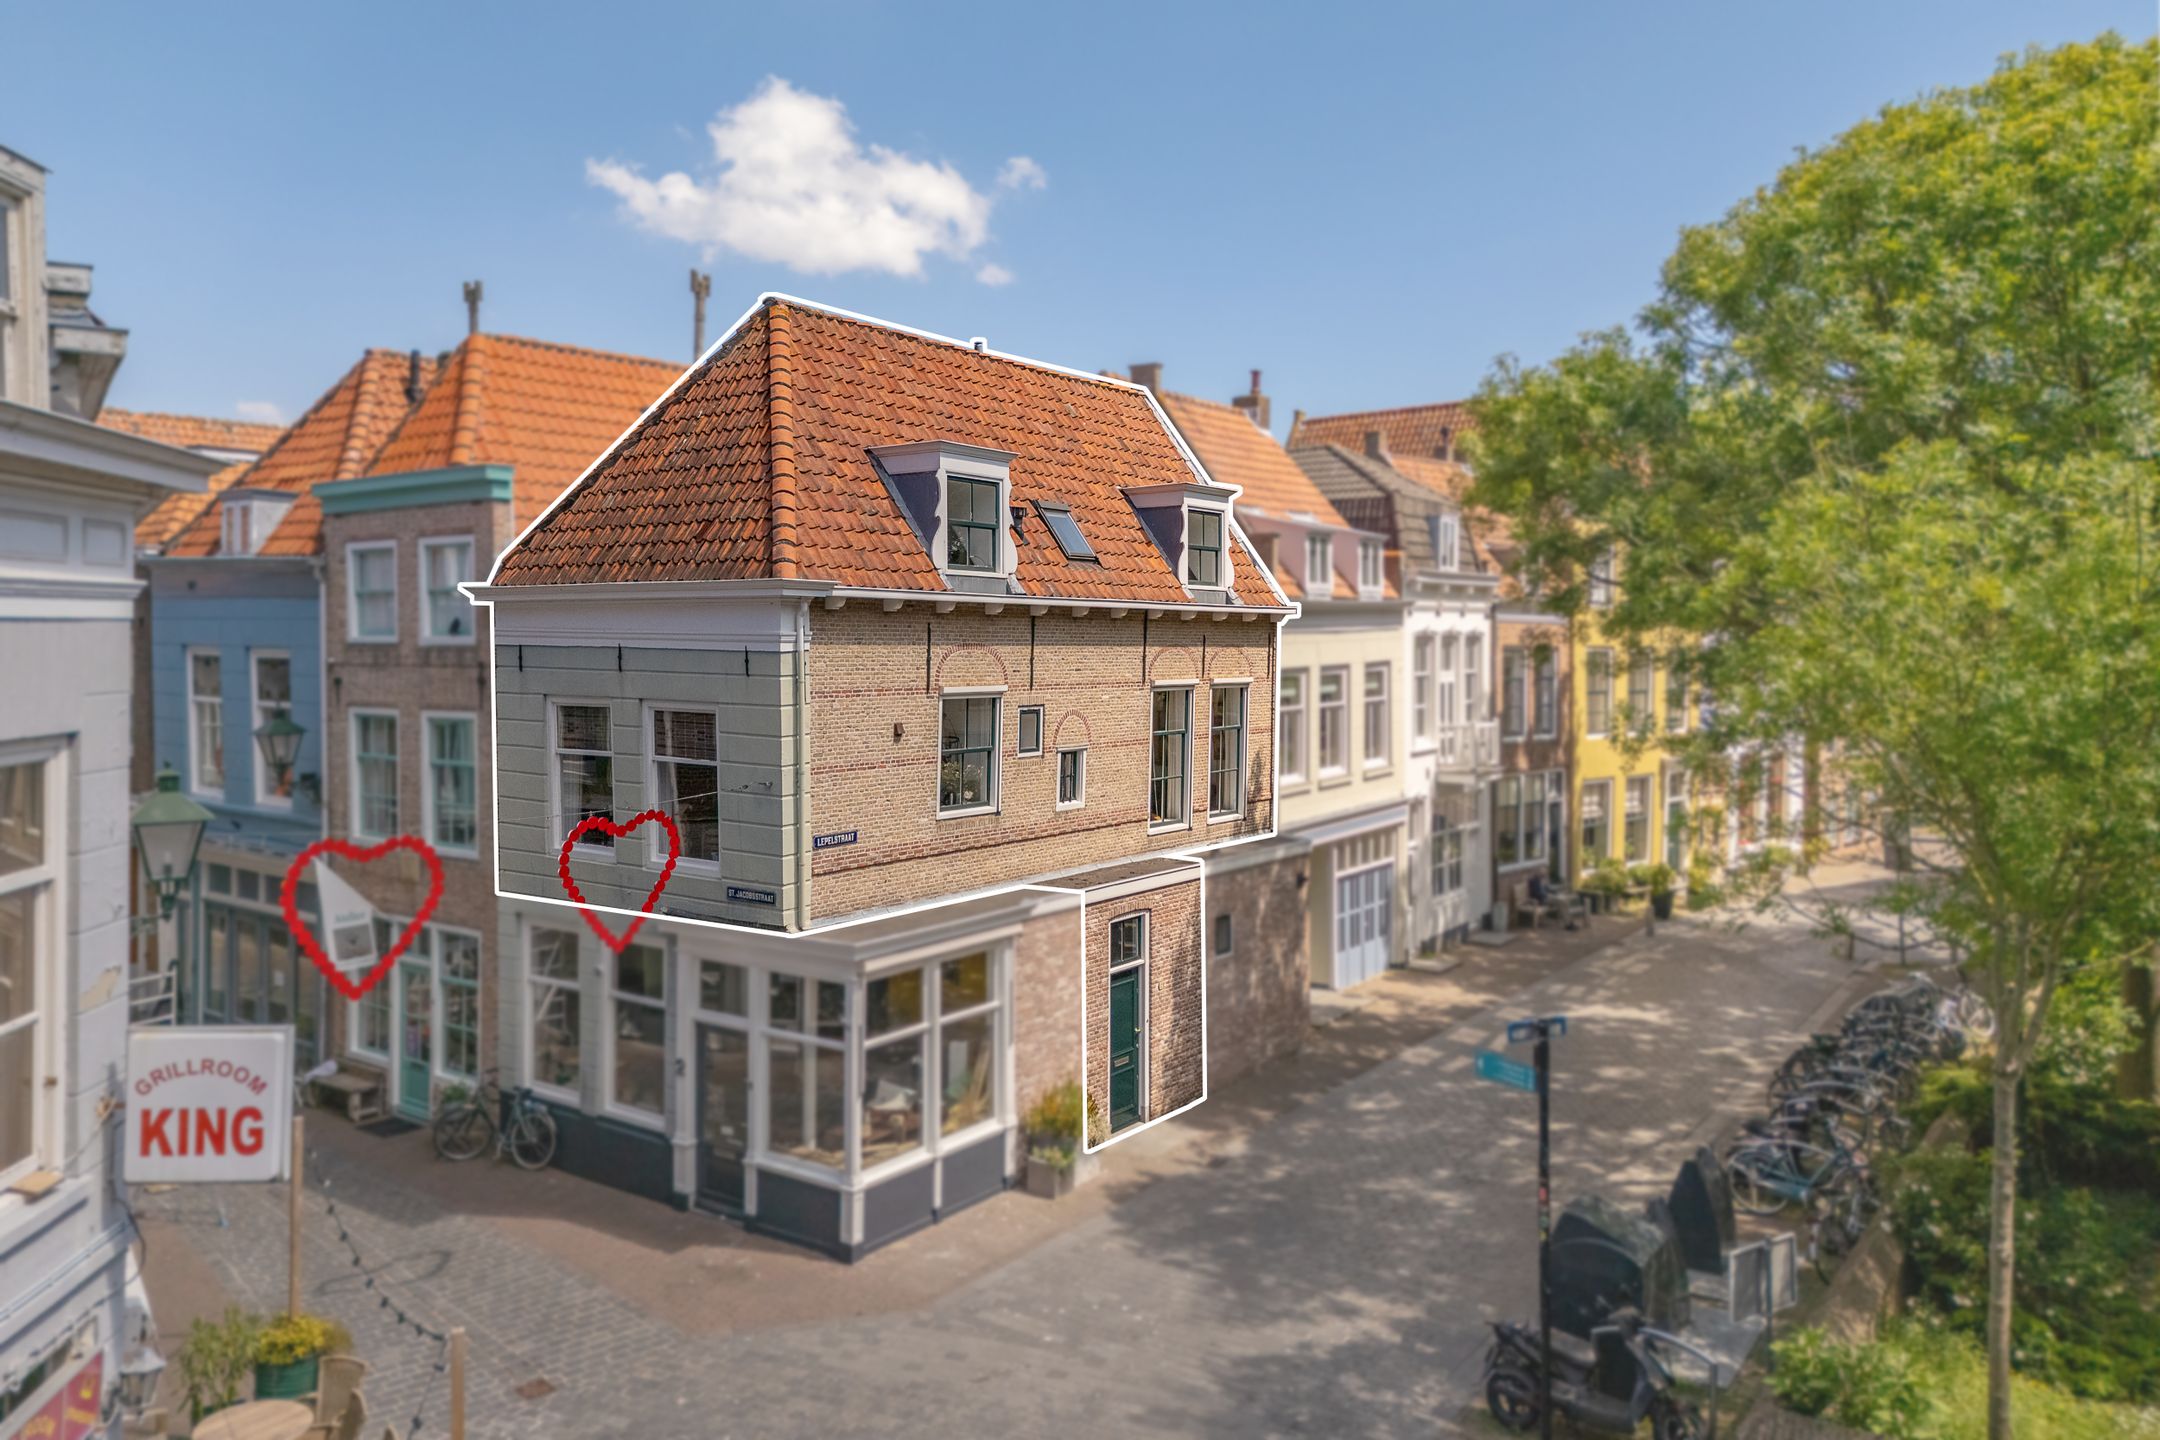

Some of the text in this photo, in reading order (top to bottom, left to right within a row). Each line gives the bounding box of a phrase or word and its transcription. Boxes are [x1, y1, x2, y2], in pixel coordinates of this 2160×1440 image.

[817, 833, 854, 847] LEPELSTRAAT
[134, 1058, 268, 1096] GRILLROOM
[139, 1106, 264, 1157] KING
